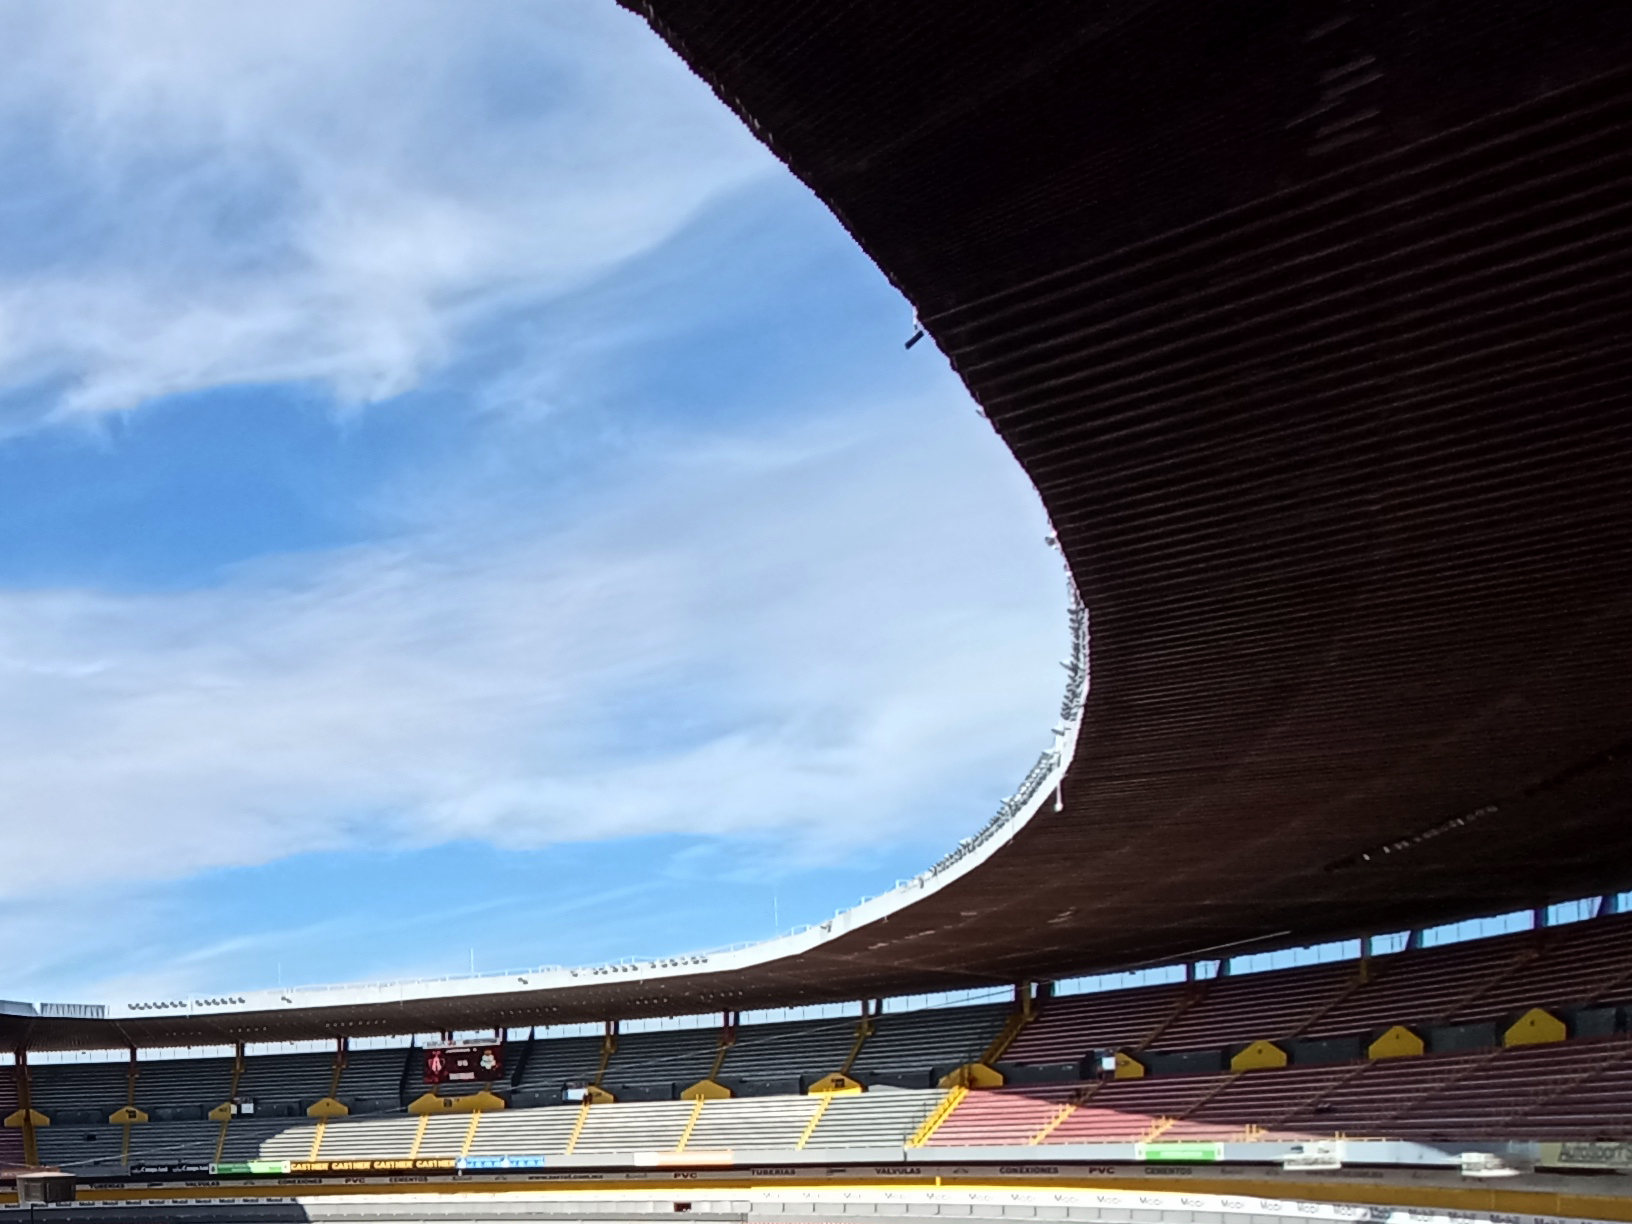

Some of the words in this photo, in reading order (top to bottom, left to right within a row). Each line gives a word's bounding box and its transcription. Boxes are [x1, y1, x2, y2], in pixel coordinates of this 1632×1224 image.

[673, 1171, 698, 1180] PVC
[750, 1168, 797, 1177] TUBERIAS
[875, 1166, 921, 1176] VALVULAS
[999, 1166, 1059, 1176] CONEXIONES
[1088, 1166, 1115, 1176] PVC
[345, 1176, 366, 1185] PVC
